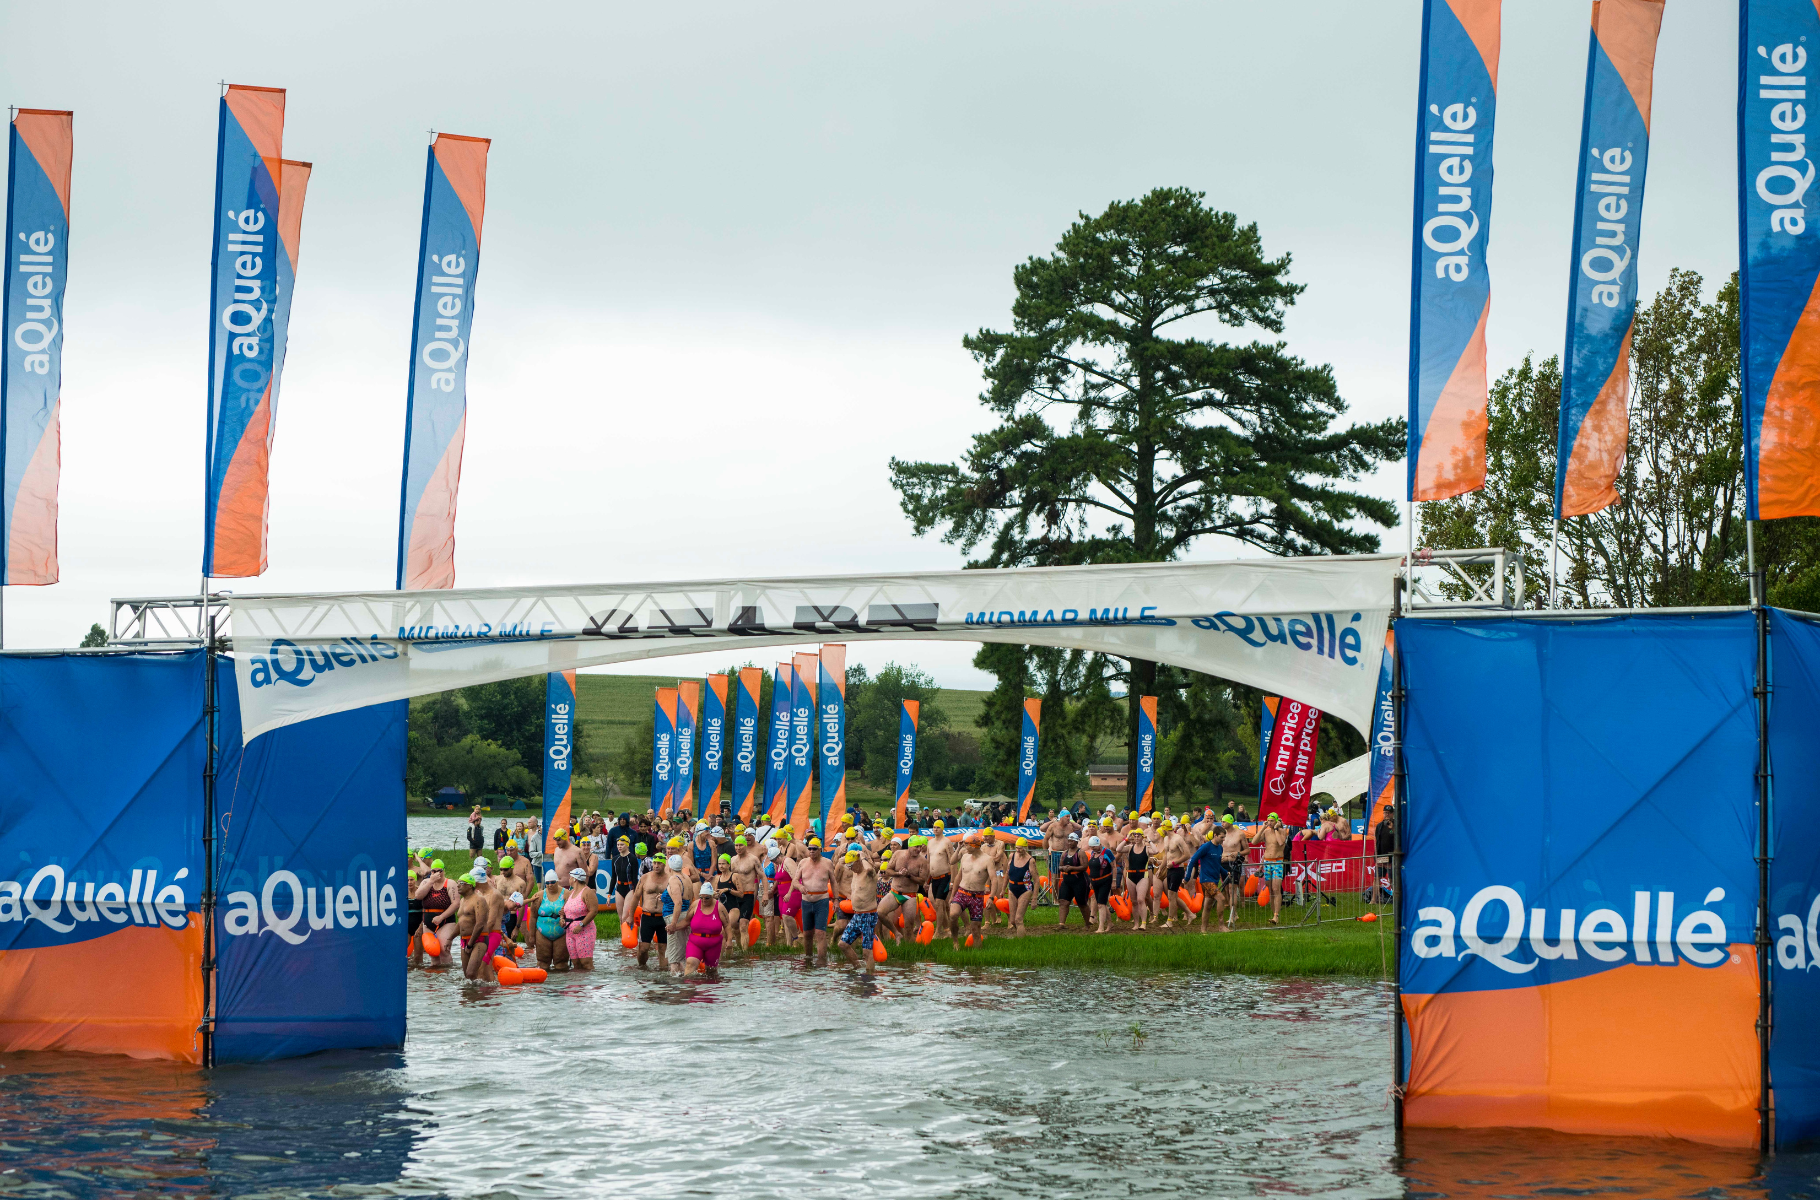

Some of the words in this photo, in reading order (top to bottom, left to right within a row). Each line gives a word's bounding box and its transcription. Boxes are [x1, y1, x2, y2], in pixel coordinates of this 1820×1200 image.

[1755, 43, 1817, 236] aQuellé
[1422, 102, 1480, 283] aQuellé
[1581, 147, 1633, 308] aQuellé
[14, 230, 56, 375] aQuellé
[222, 208, 268, 358] aQuellé
[422, 252, 466, 393] aQuellé
[250, 634, 399, 687] aQuellé
[1190, 611, 1362, 667] aQuellé
[550, 703, 570, 770] aQuellé
[655, 733, 671, 781] aQuellé
[677, 727, 692, 775] aQuellé
[705, 717, 721, 771] aQuellé
[737, 717, 755, 772] aQuellé
[771, 711, 790, 771] aQuellé
[791, 707, 809, 766] aQuellé
[823, 703, 842, 766] aQuellé
[900, 734, 913, 775] aQuellé
[1022, 736, 1035, 776] aQuellé
[1141, 734, 1152, 773] aQuellé
[0, 864, 189, 933] aQuellé
[224, 866, 397, 945] aQuellé
[1411, 885, 1727, 974] aQuellé
